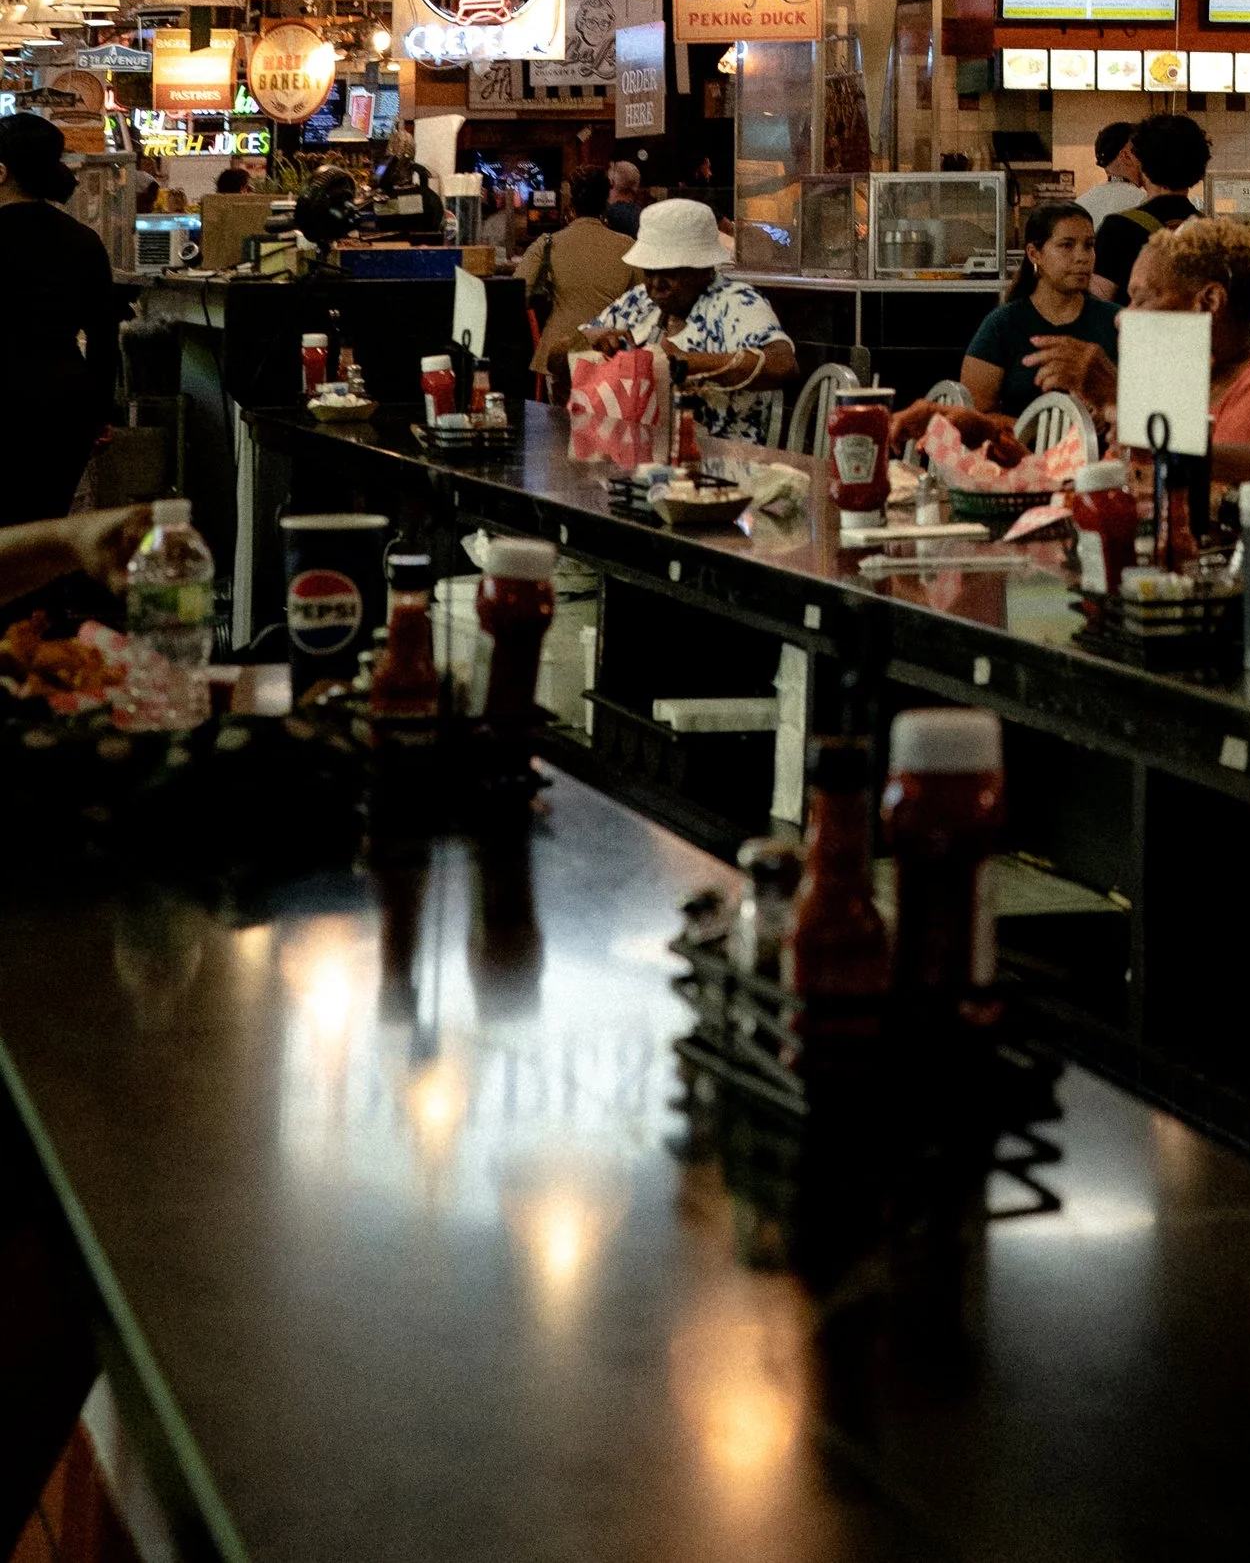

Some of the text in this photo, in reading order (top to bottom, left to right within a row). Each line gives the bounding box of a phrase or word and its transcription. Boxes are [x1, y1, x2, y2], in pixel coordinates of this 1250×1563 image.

[689, 11, 807, 26] PEKING DUCK
[103, 54, 148, 66] AVENUE
[621, 68, 657, 95] ORDER
[169, 90, 222, 101] PASTRIES
[625, 102, 654, 128] HERE
[144, 130, 271, 156] FRESH JUICES
[293, 602, 356, 620] PEPSI
